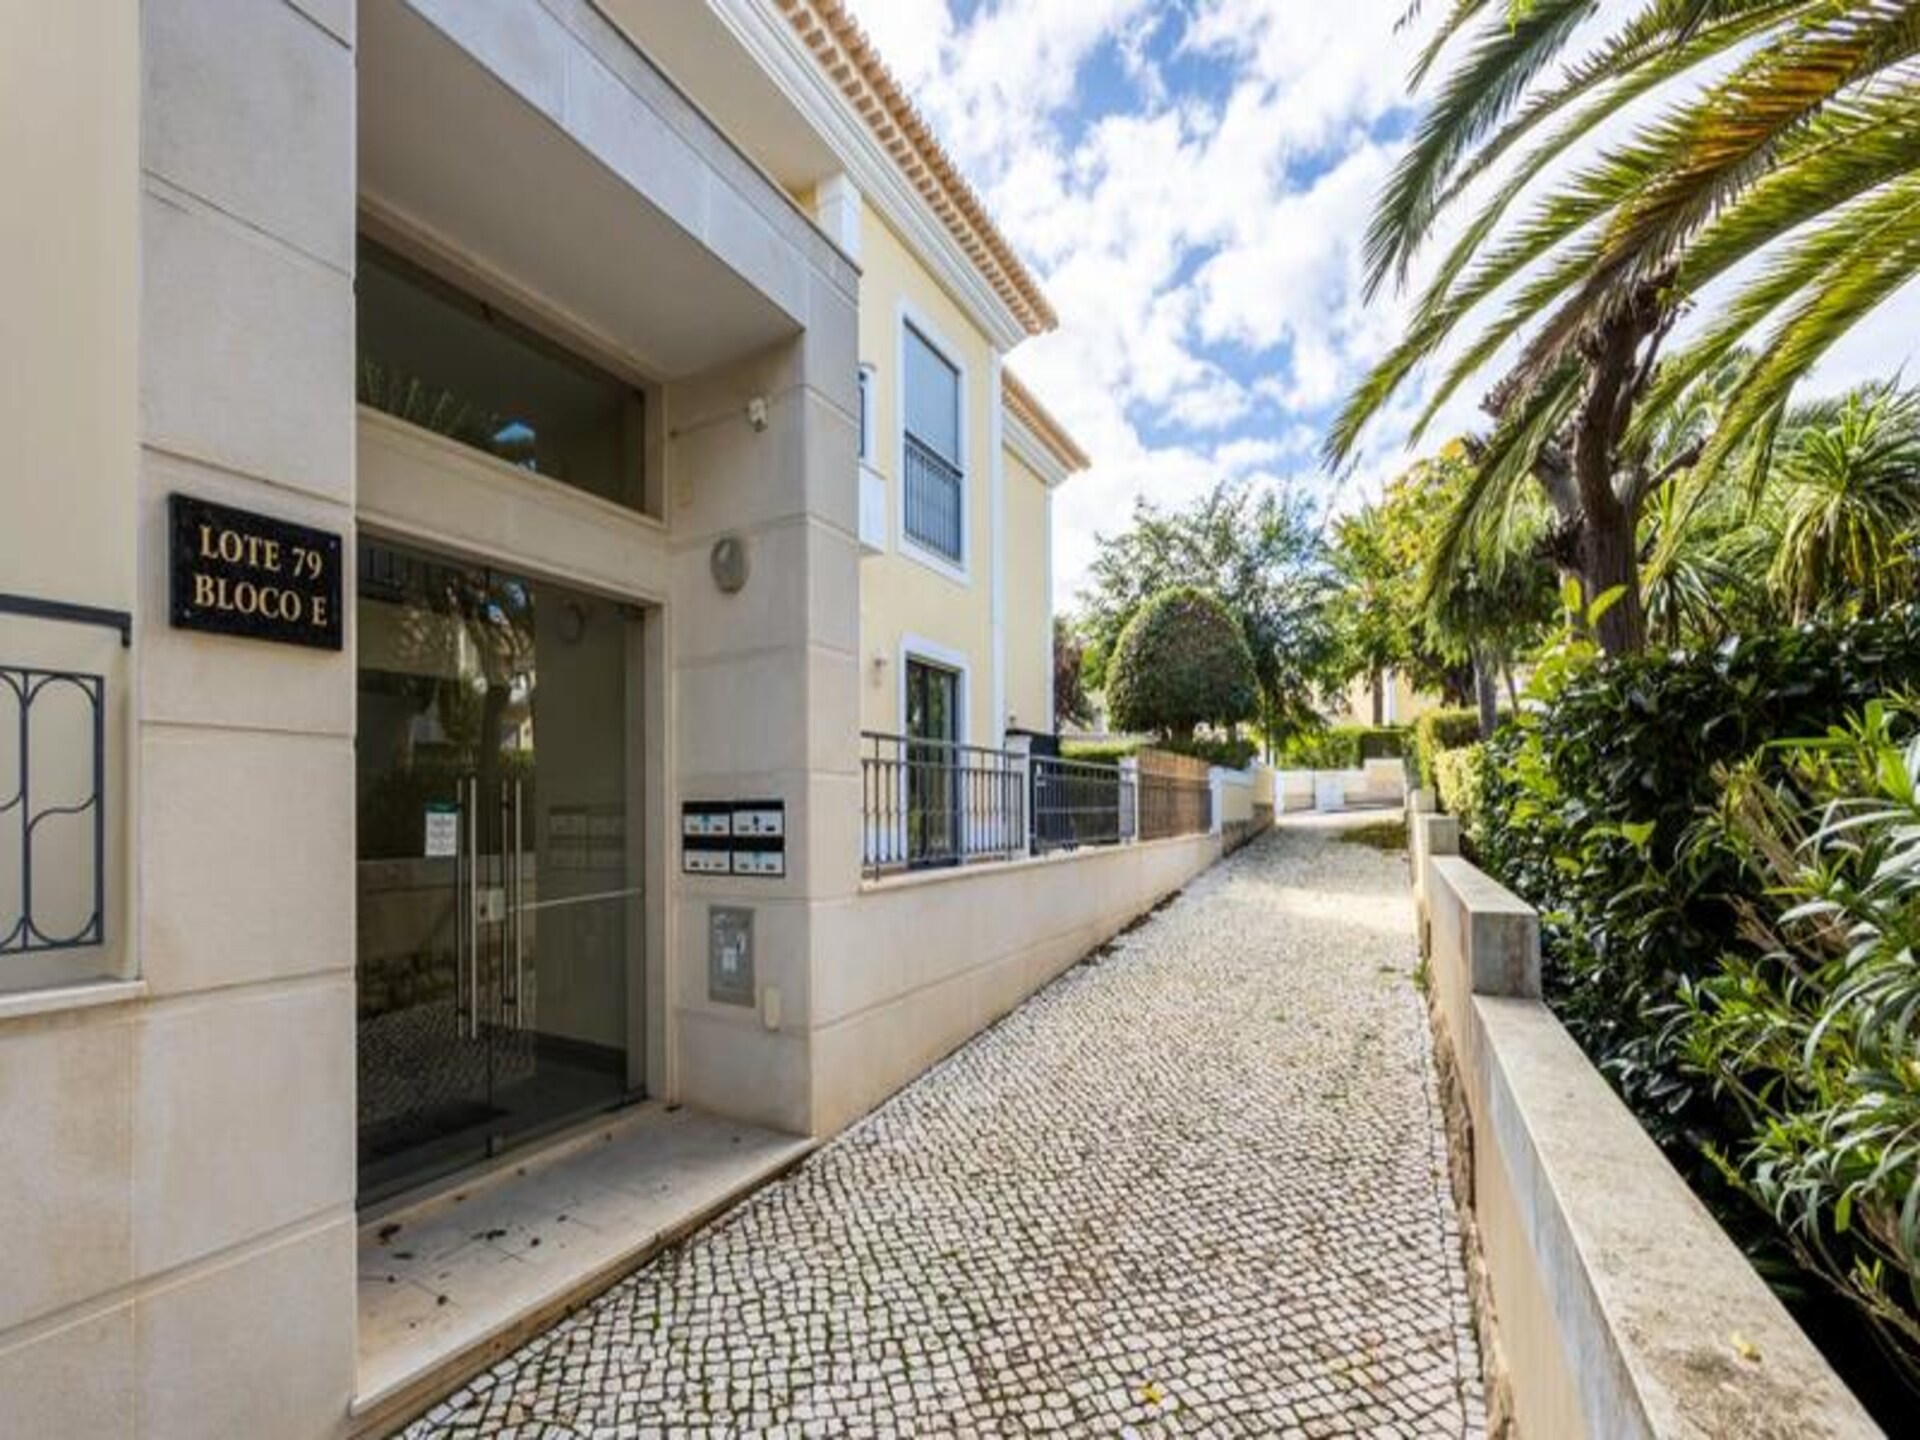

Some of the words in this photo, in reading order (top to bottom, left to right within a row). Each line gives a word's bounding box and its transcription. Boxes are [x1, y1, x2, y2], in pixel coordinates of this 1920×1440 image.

[200, 524, 281, 571] LOTE
[292, 547, 322, 579] 79
[194, 573, 301, 621] BLOCO
[311, 596, 327, 626] E
